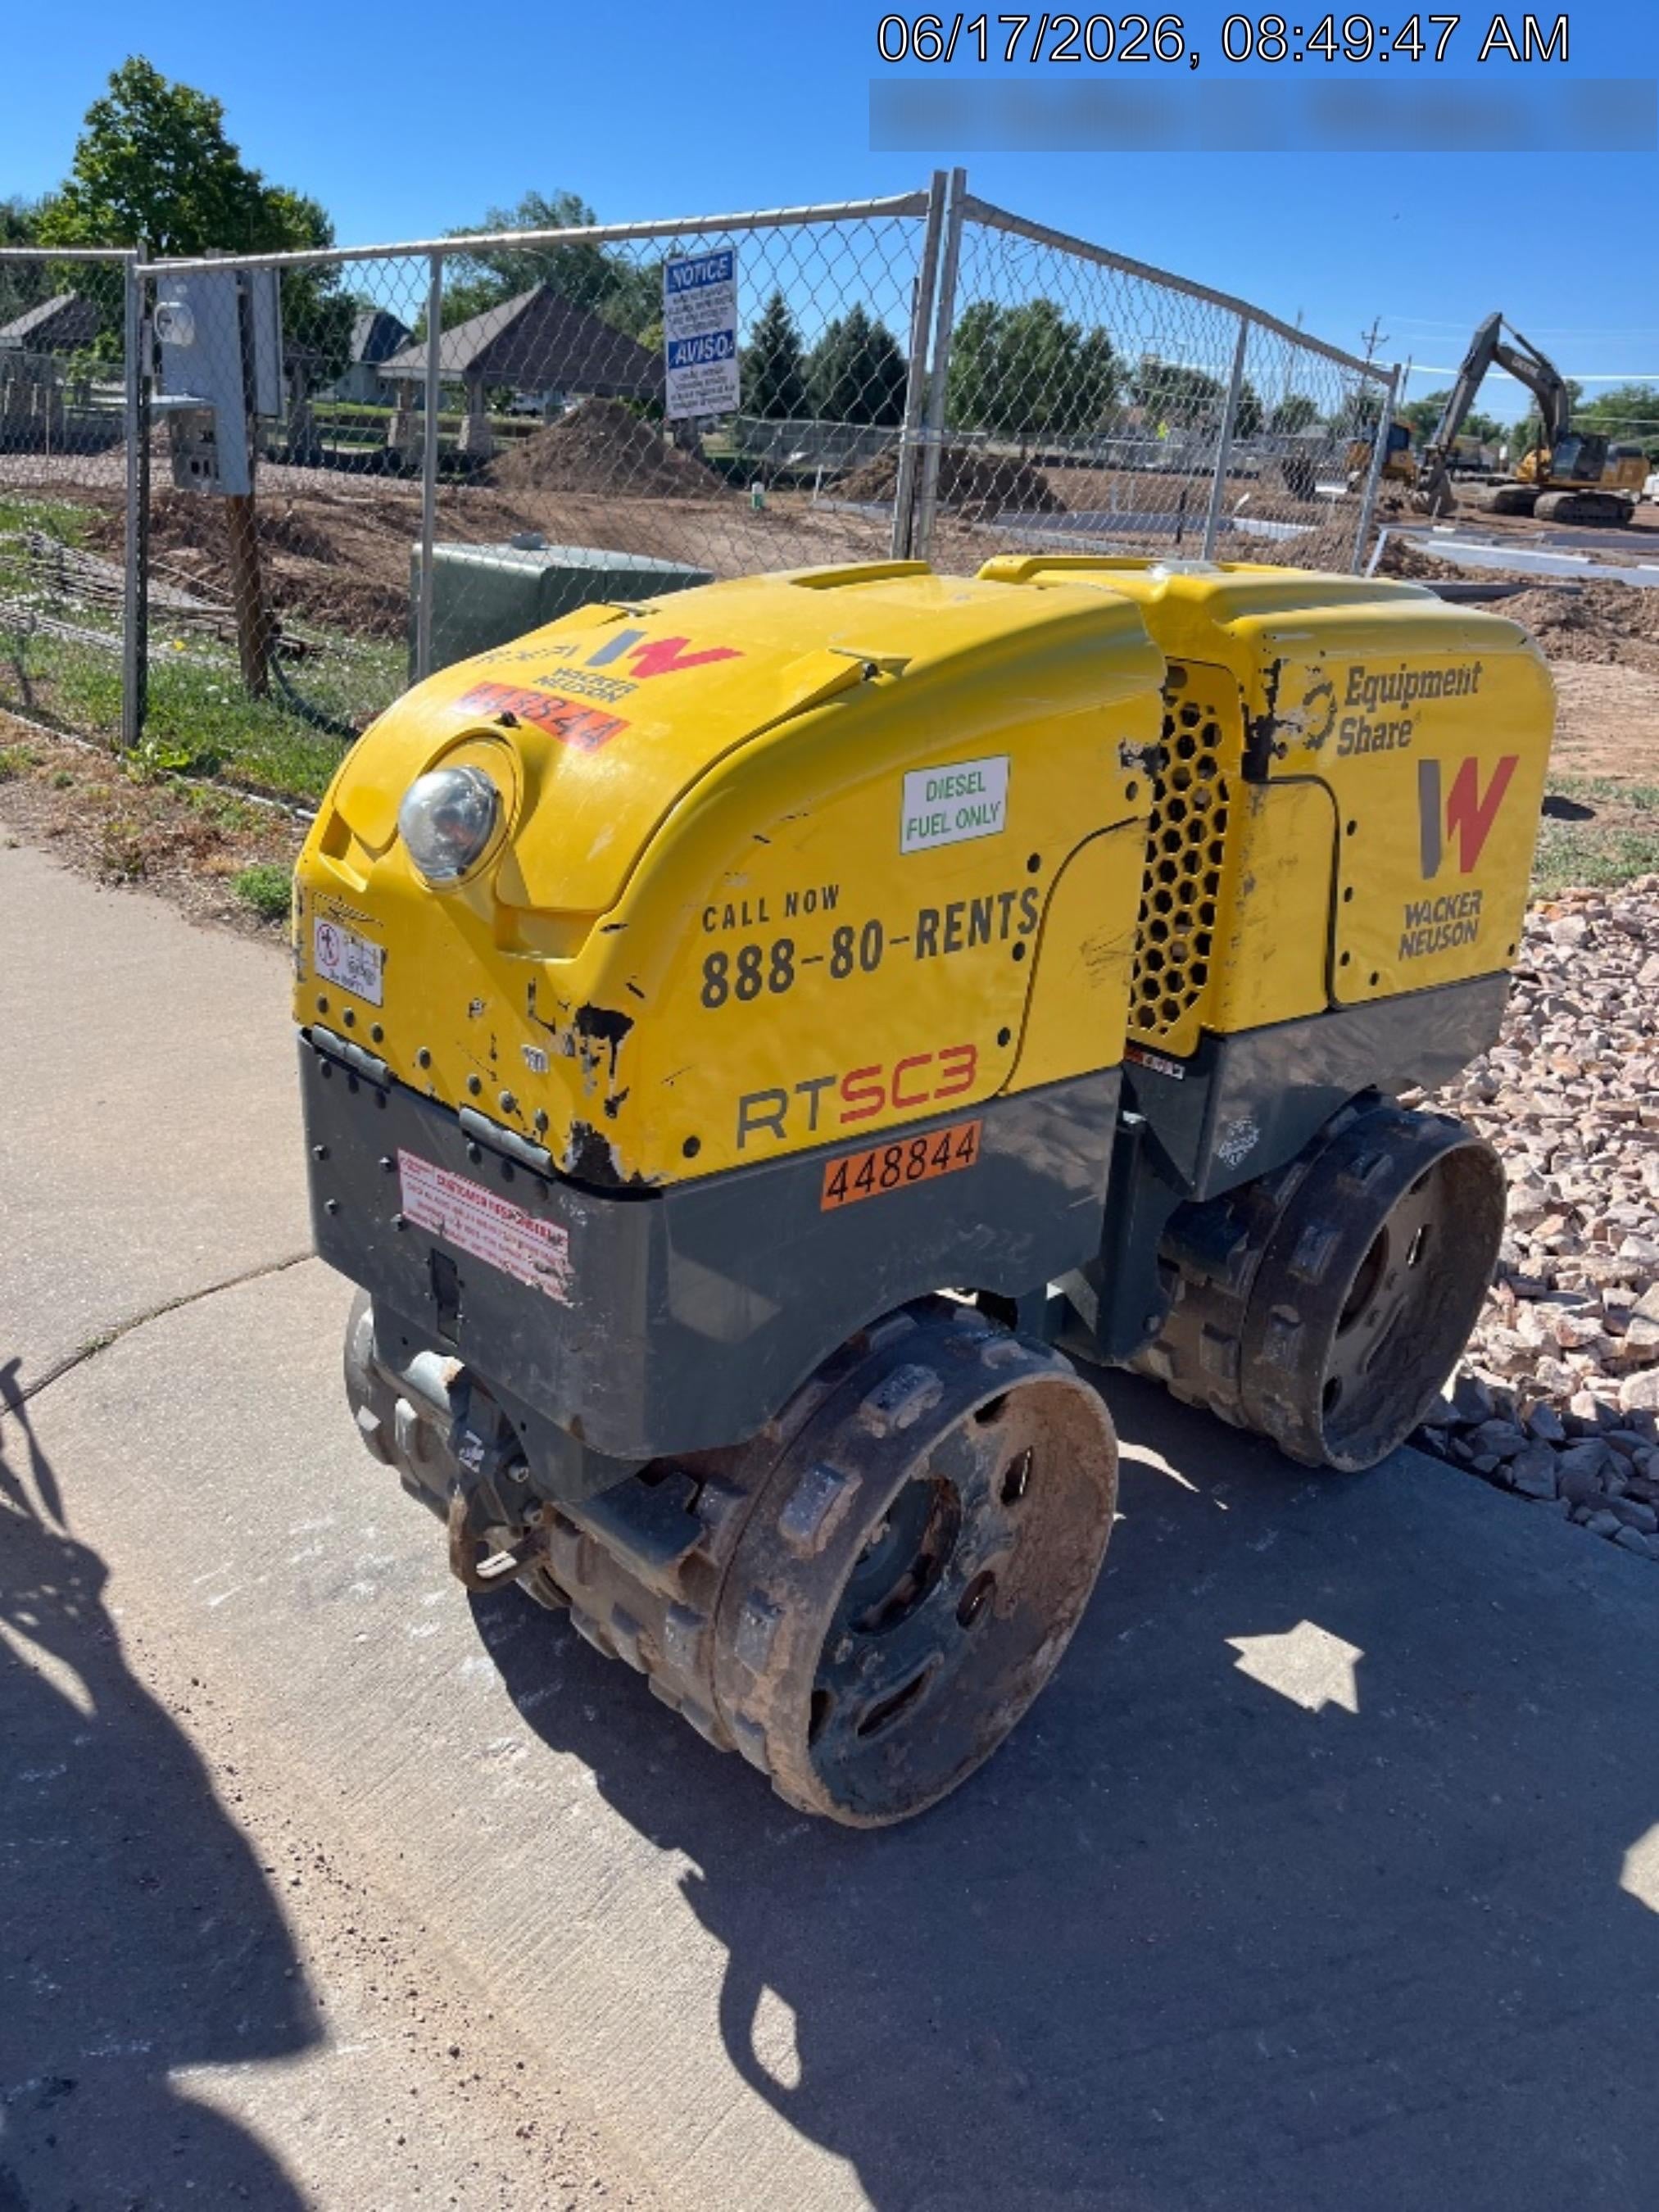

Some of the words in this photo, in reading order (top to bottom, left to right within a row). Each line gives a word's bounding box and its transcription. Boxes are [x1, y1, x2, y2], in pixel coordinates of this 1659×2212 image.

[672, 255, 729, 288] NOTICE
[675, 334, 729, 366] AVISO
[1344, 660, 1483, 713] Equipment
[1337, 715, 1413, 756] Share
[926, 771, 986, 802] DIESEL
[906, 812, 951, 841] FUEL
[955, 800, 1001, 829] ONLY
[702, 898, 768, 933] CALL
[785, 884, 840, 918] NOW
[1403, 889, 1483, 930] WACKER
[700, 886, 1039, 1009] 888-80-RENTS
[1398, 918, 1480, 962] NEUSON
[737, 1044, 978, 1150] RTSC3
[825, 1125, 975, 1203] 448844
